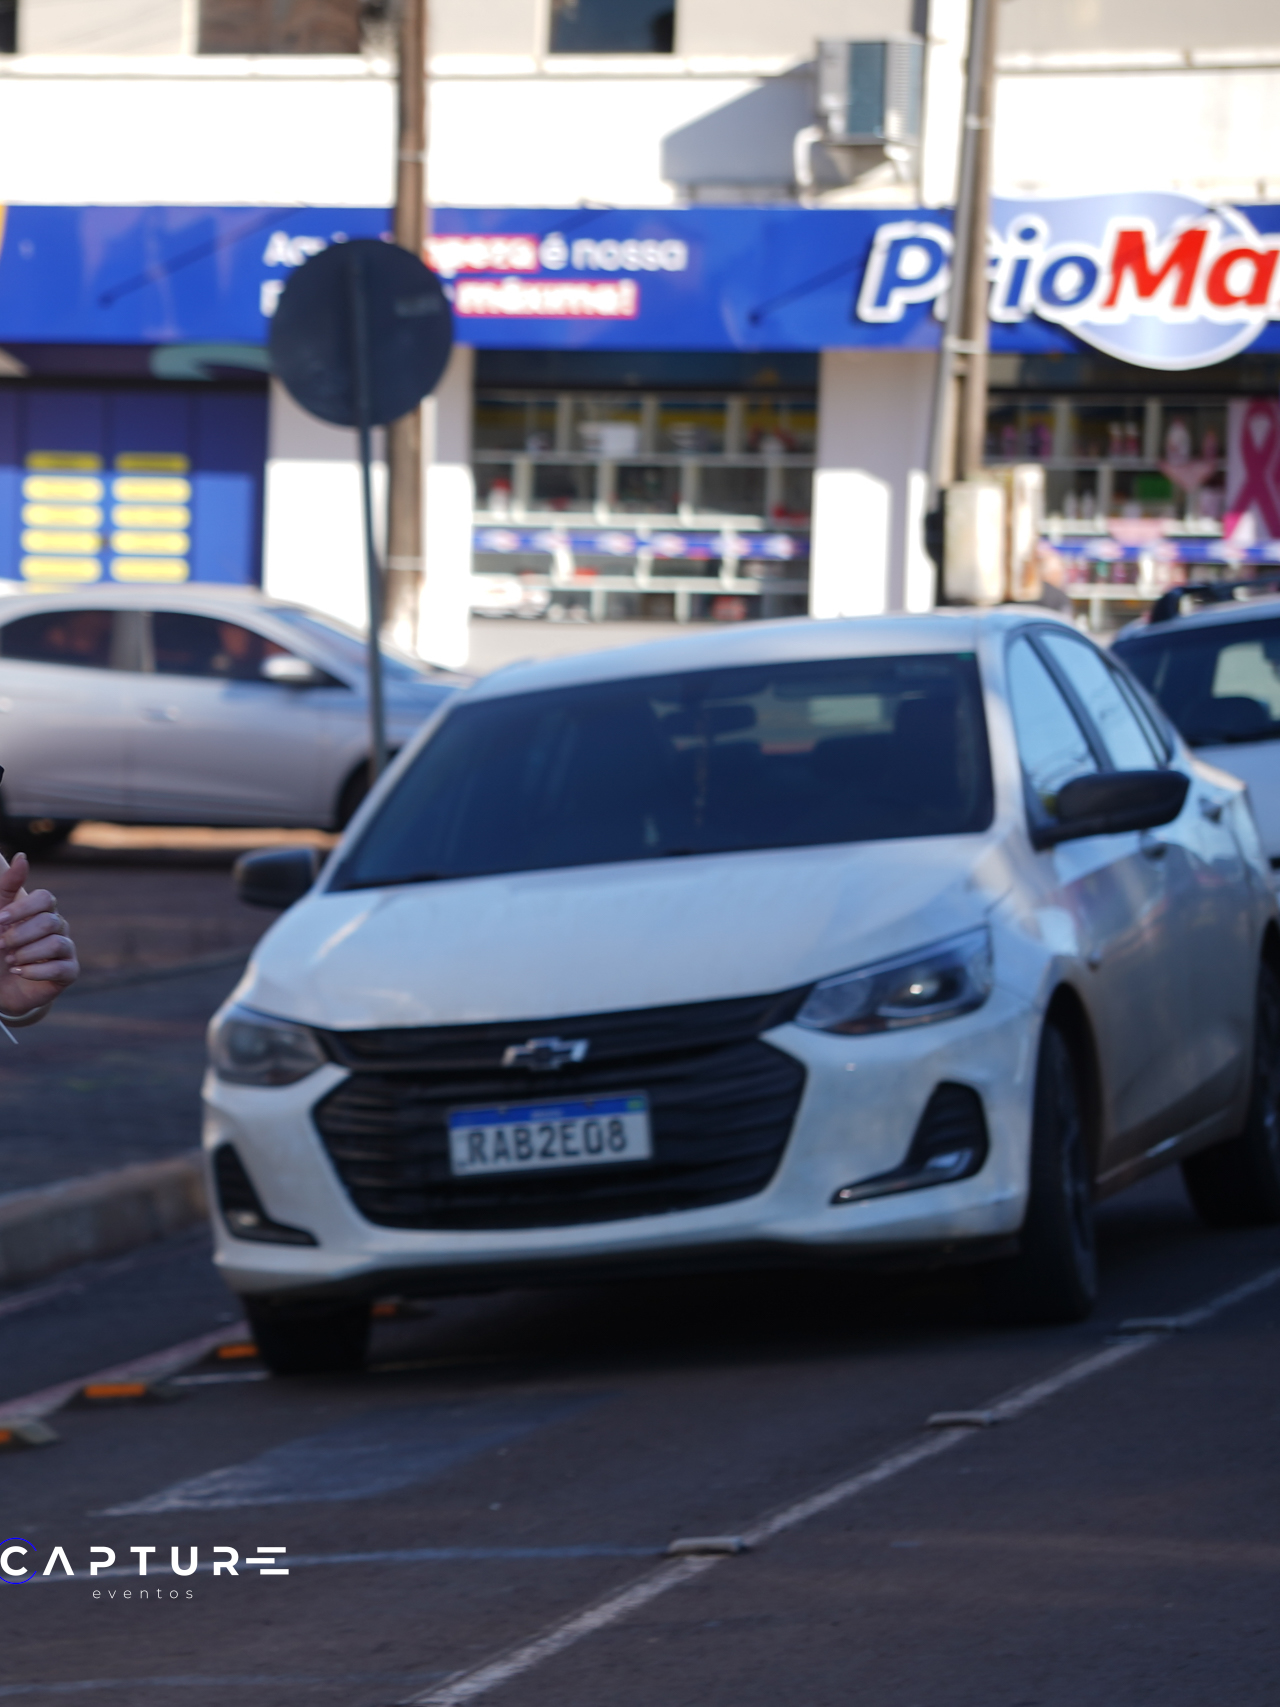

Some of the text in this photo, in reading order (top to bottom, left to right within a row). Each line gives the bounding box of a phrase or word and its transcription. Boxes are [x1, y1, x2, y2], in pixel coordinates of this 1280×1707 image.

[539, 232, 569, 271] é
[571, 239, 687, 271] nossa
[868, 224, 1280, 310] PioMa
[467, 1118, 627, 1165] RAB2E08
